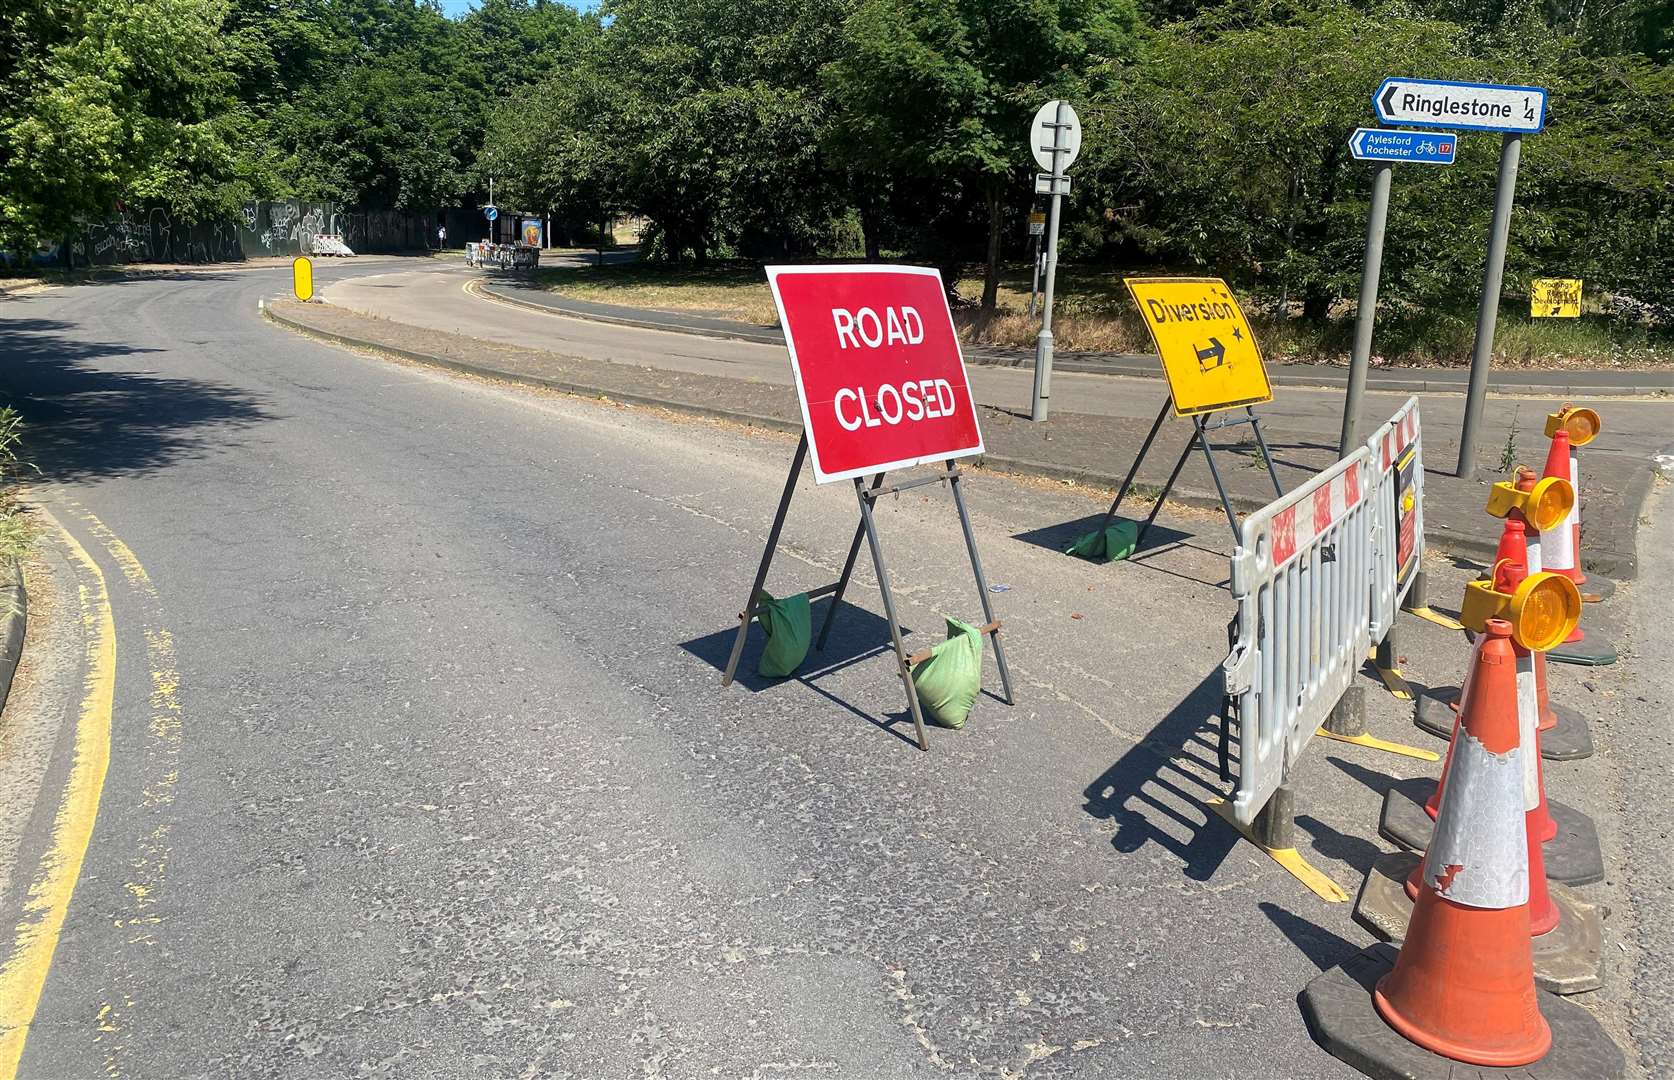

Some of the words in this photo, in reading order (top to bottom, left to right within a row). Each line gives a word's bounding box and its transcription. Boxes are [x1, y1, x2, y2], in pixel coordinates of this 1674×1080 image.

[1402, 94, 1512, 118] Ringlestone
[1366, 145, 1412, 156] Rochester
[1367, 134, 1412, 145] Aylesford
[1146, 297, 1236, 323] Diversion
[831, 306, 924, 349] ROAD
[834, 379, 956, 431] CLOSED
